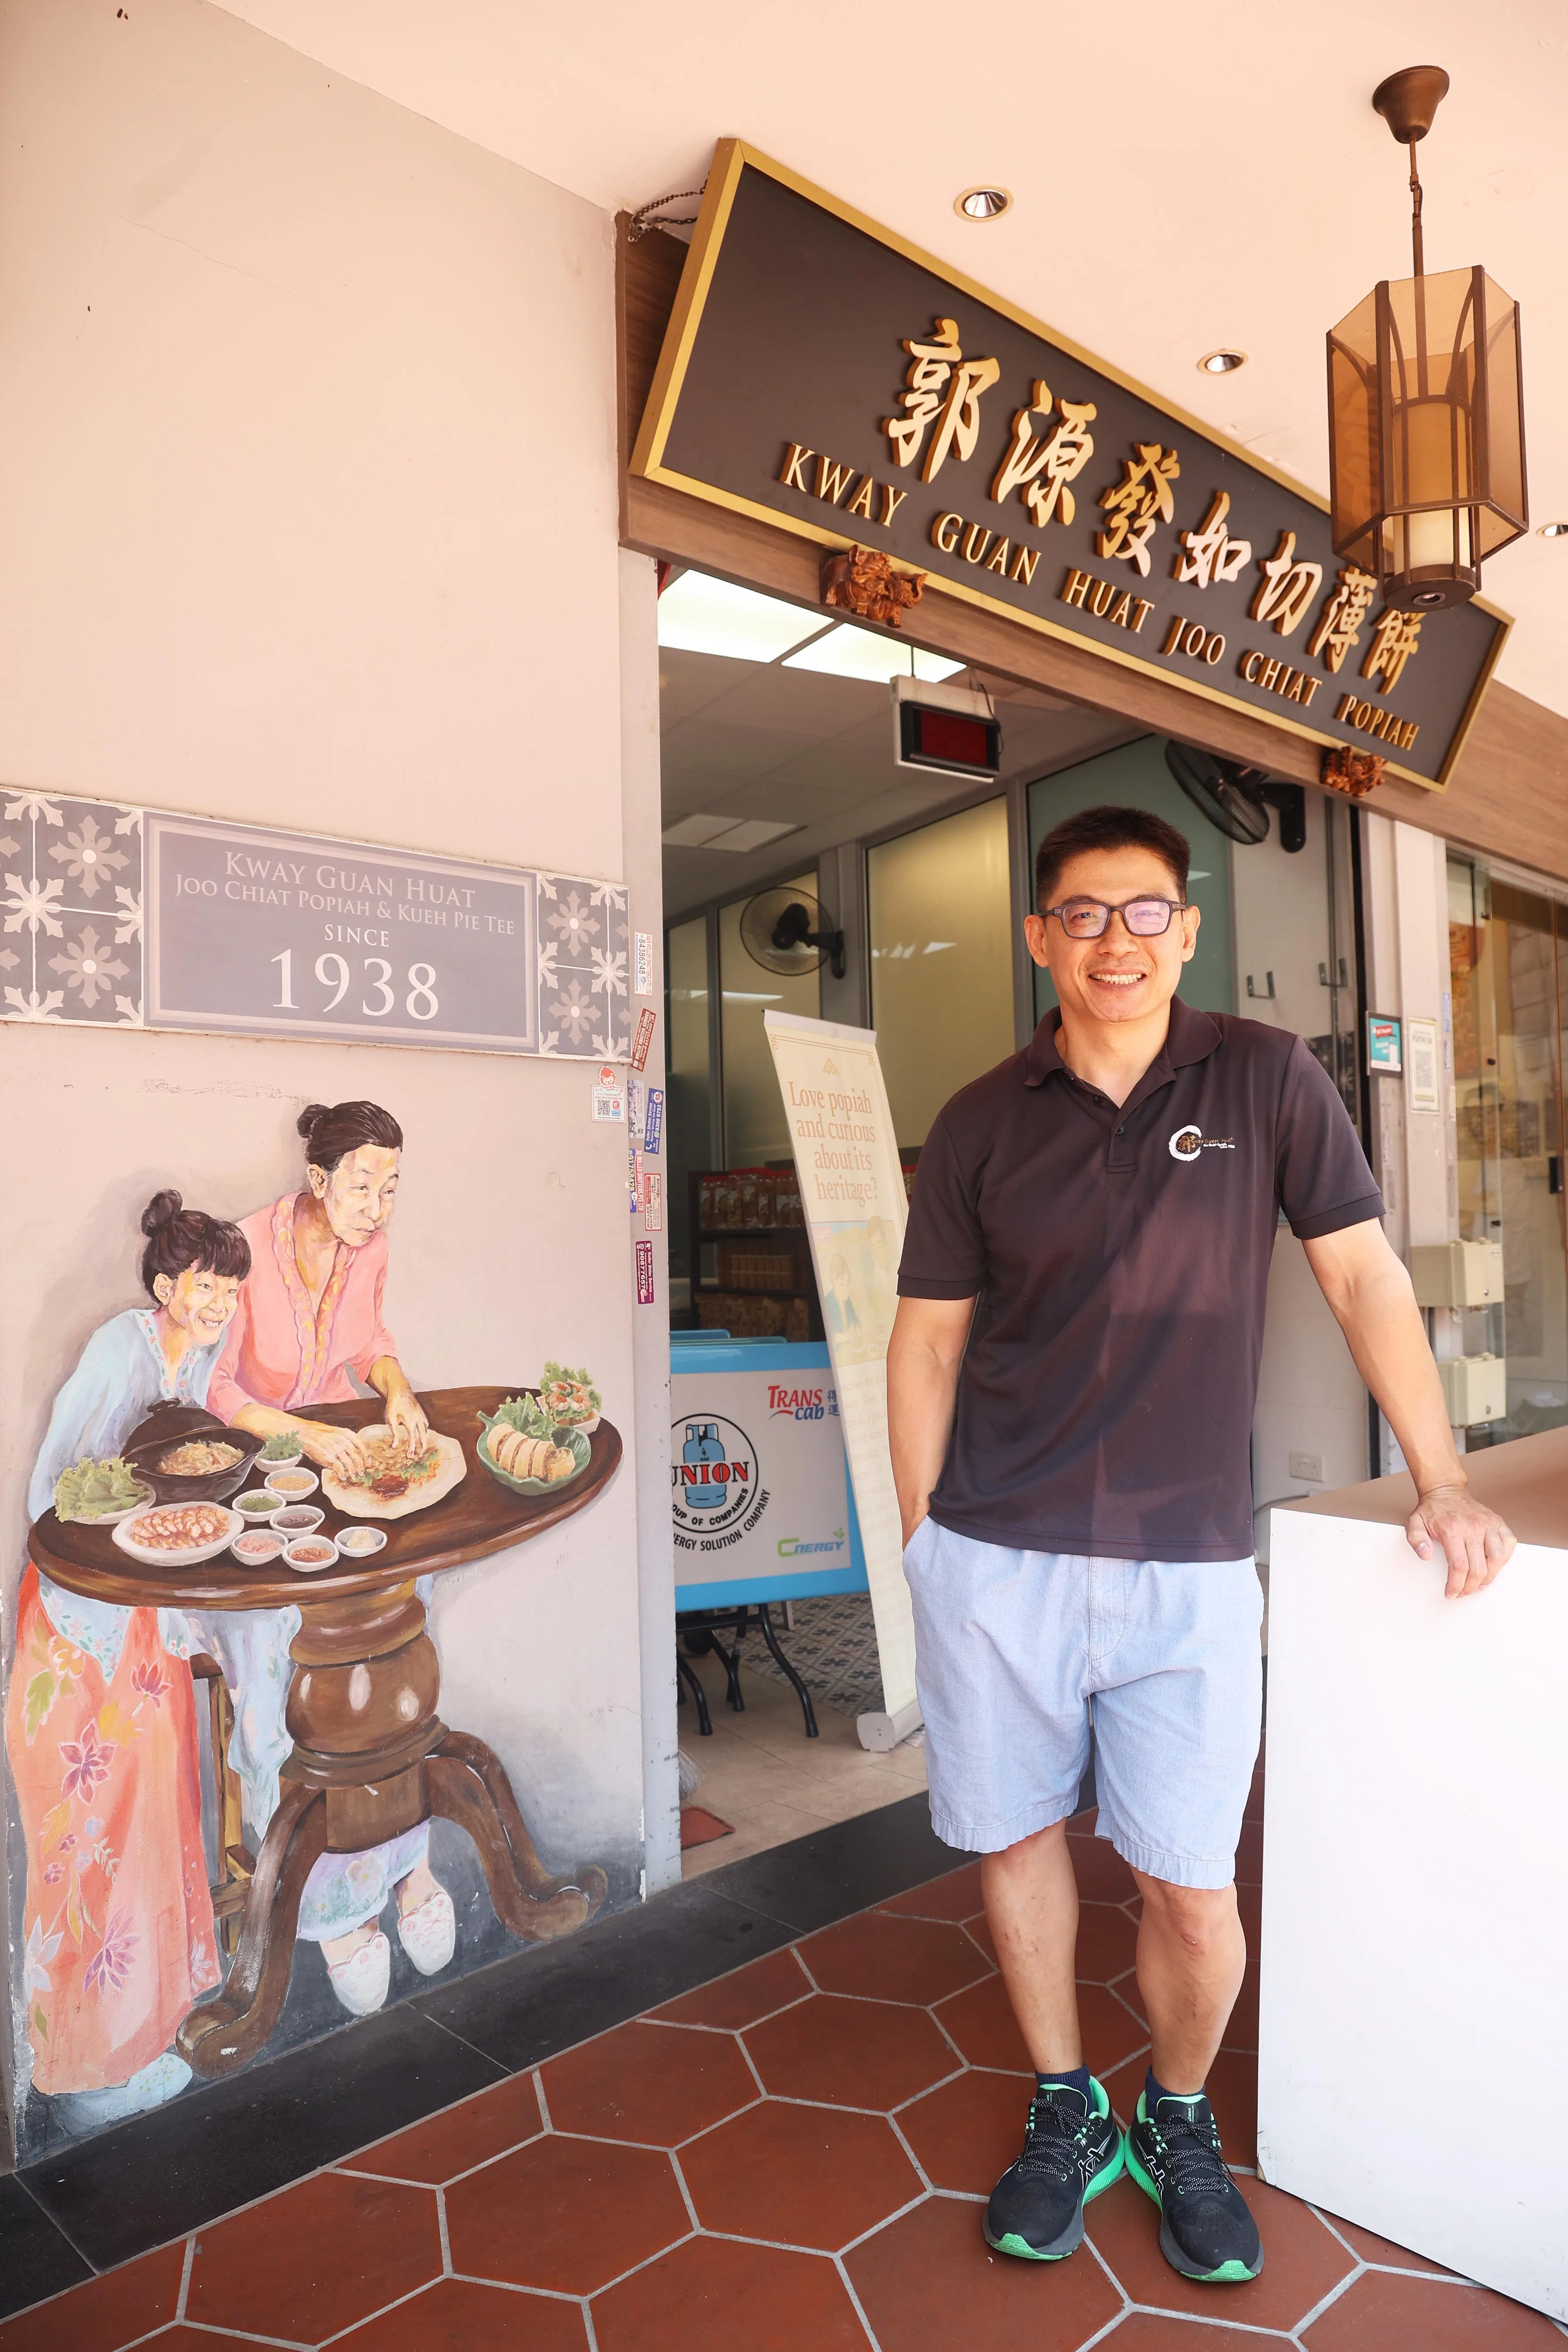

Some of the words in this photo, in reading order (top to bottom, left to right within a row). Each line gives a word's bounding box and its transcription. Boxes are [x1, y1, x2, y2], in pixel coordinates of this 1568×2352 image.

[780, 443, 908, 527] KWAY
[932, 512, 1042, 585] GUAN
[1062, 569, 1155, 633] HUAT
[1163, 617, 1226, 665] JOO
[1241, 650, 1322, 706] CHIAT
[1336, 694, 1420, 750] POPIAH
[225, 851, 306, 884] KWAY
[316, 866, 394, 897] GUAN
[405, 878, 476, 908] HUAT
[175, 874, 218, 897] JOO
[225, 881, 291, 906] CHIAT
[298, 890, 371, 916] POPIAH
[377, 901, 392, 919] &
[398, 904, 446, 926] KUEH
[454, 912, 480, 930] PIE
[485, 915, 514, 934] TEE
[324, 924, 389, 948] SINCE
[270, 949, 439, 1020] 1938
[788, 1081, 825, 1108] Love
[828, 1088, 873, 1121] popiah
[796, 1112, 825, 1138] and
[828, 1122, 876, 1142] curious
[814, 1144, 852, 1170] about
[854, 1146, 872, 1170] its
[814, 1174, 877, 1208] heritage?
[795, 1404, 824, 1420] cab
[672, 1504, 687, 1519] OUP
[691, 1517, 704, 1526] OF
[709, 1488, 749, 1525] COMPANIES
[674, 1533, 697, 1550] ERGY
[700, 1529, 743, 1551] SOLUTION
[744, 1489, 771, 1531] COMPANY
